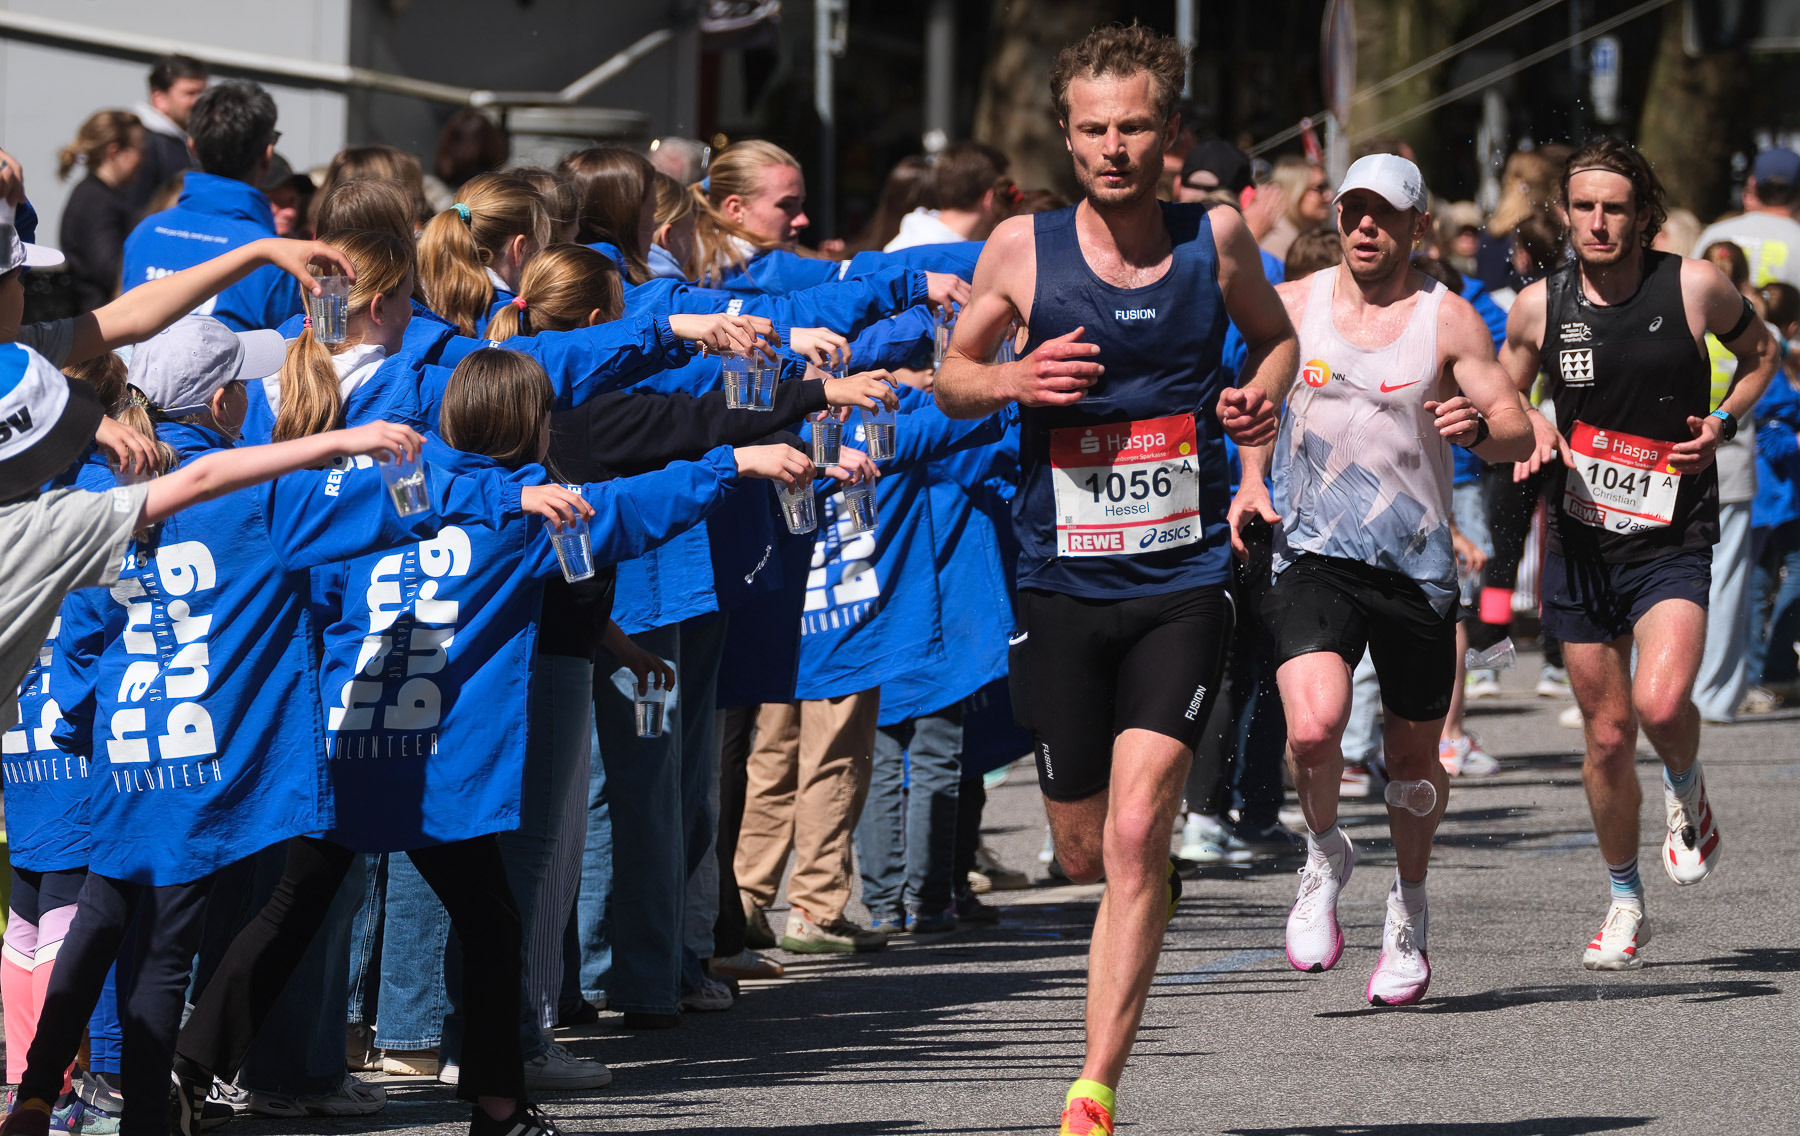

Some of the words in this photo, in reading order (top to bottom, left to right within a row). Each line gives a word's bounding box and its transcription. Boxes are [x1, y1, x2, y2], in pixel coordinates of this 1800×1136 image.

[1115, 308, 1156, 320] FUSION
[1332, 373, 1346, 381] NN
[1107, 432, 1166, 452] Haspa
[1612, 439, 1659, 462] Haspa
[1139, 452, 1167, 460] Sparkasse
[1179, 459, 1193, 474] A
[1085, 466, 1172, 503] 1056
[1587, 463, 1651, 498] 1041
[1662, 476, 1673, 488] A
[1592, 487, 1636, 507] Christian
[1105, 502, 1150, 517] Hessel
[1571, 501, 1605, 524] REWE
[1070, 534, 1122, 550] REWE
[1158, 525, 1191, 543] asics
[142, 573, 168, 636] MARATHON
[1184, 685, 1207, 721] FUSION
[325, 733, 438, 760] VOLUNTEER
[3, 755, 88, 783] VOLUNTEER
[1042, 743, 1054, 780] FUSION
[111, 759, 222, 794] VOLUNTEER
